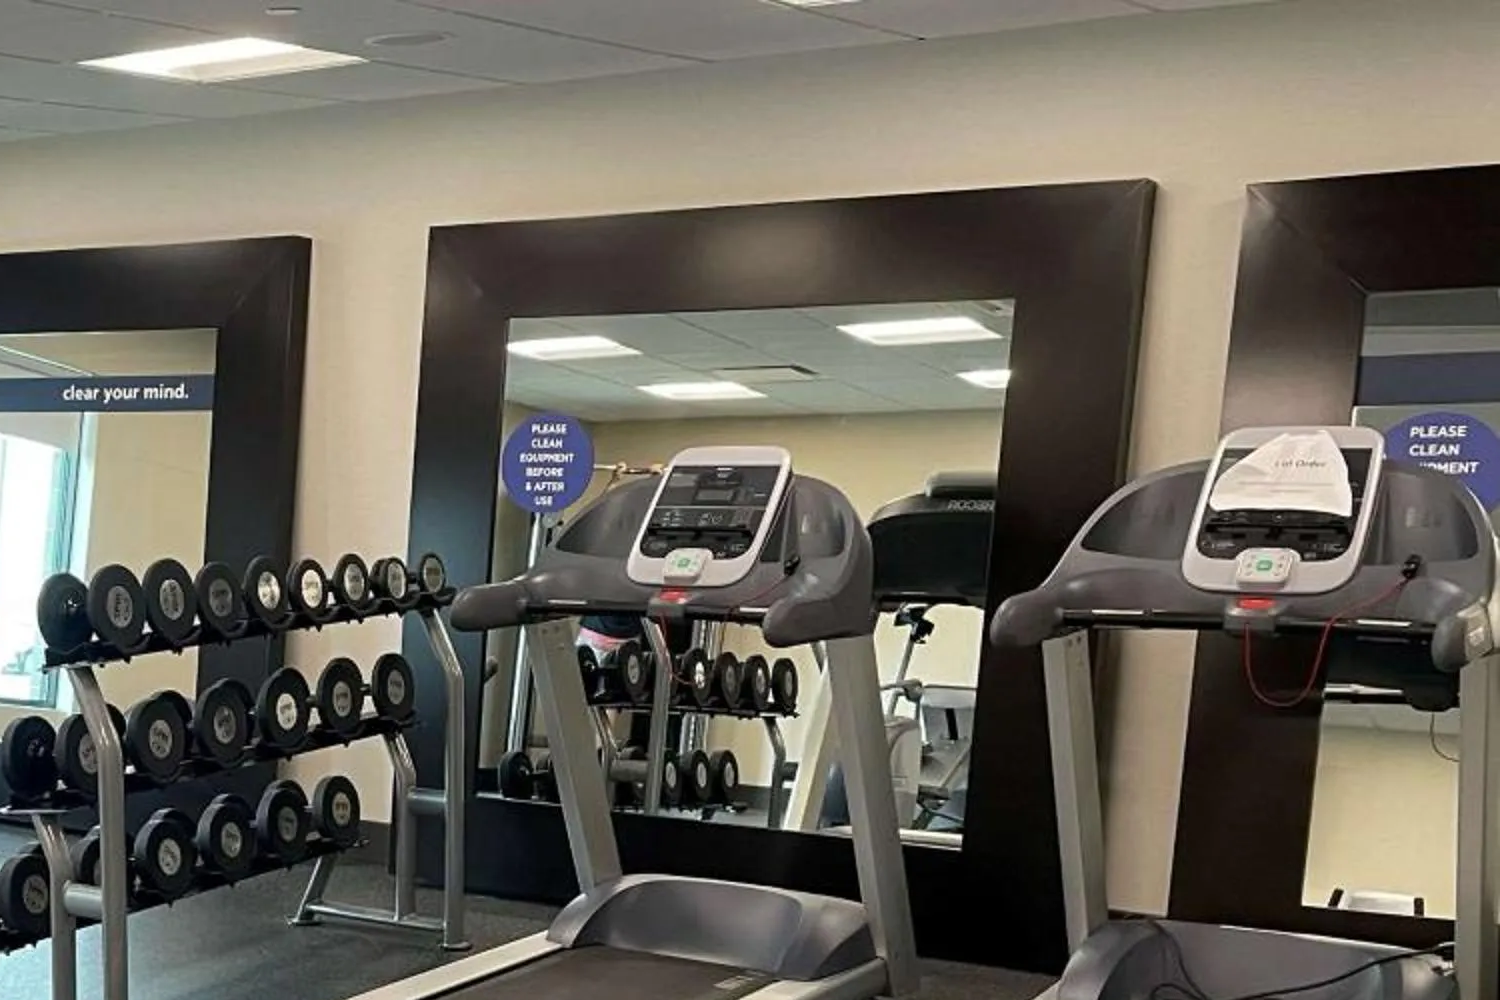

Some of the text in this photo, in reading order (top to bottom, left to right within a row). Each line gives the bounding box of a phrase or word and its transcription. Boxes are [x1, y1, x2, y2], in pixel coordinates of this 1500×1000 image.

[63, 382, 189, 404] clear your mind.
[531, 423, 568, 434] PLEASE
[1409, 425, 1468, 438] PLEASE
[531, 438, 563, 448] CLEAN
[1409, 443, 1460, 456] CLEAN
[519, 452, 574, 463] EQUIPMENT
[525, 467, 564, 477] BEFORE
[534, 481, 565, 492] AFTER
[534, 495, 553, 506] USE
